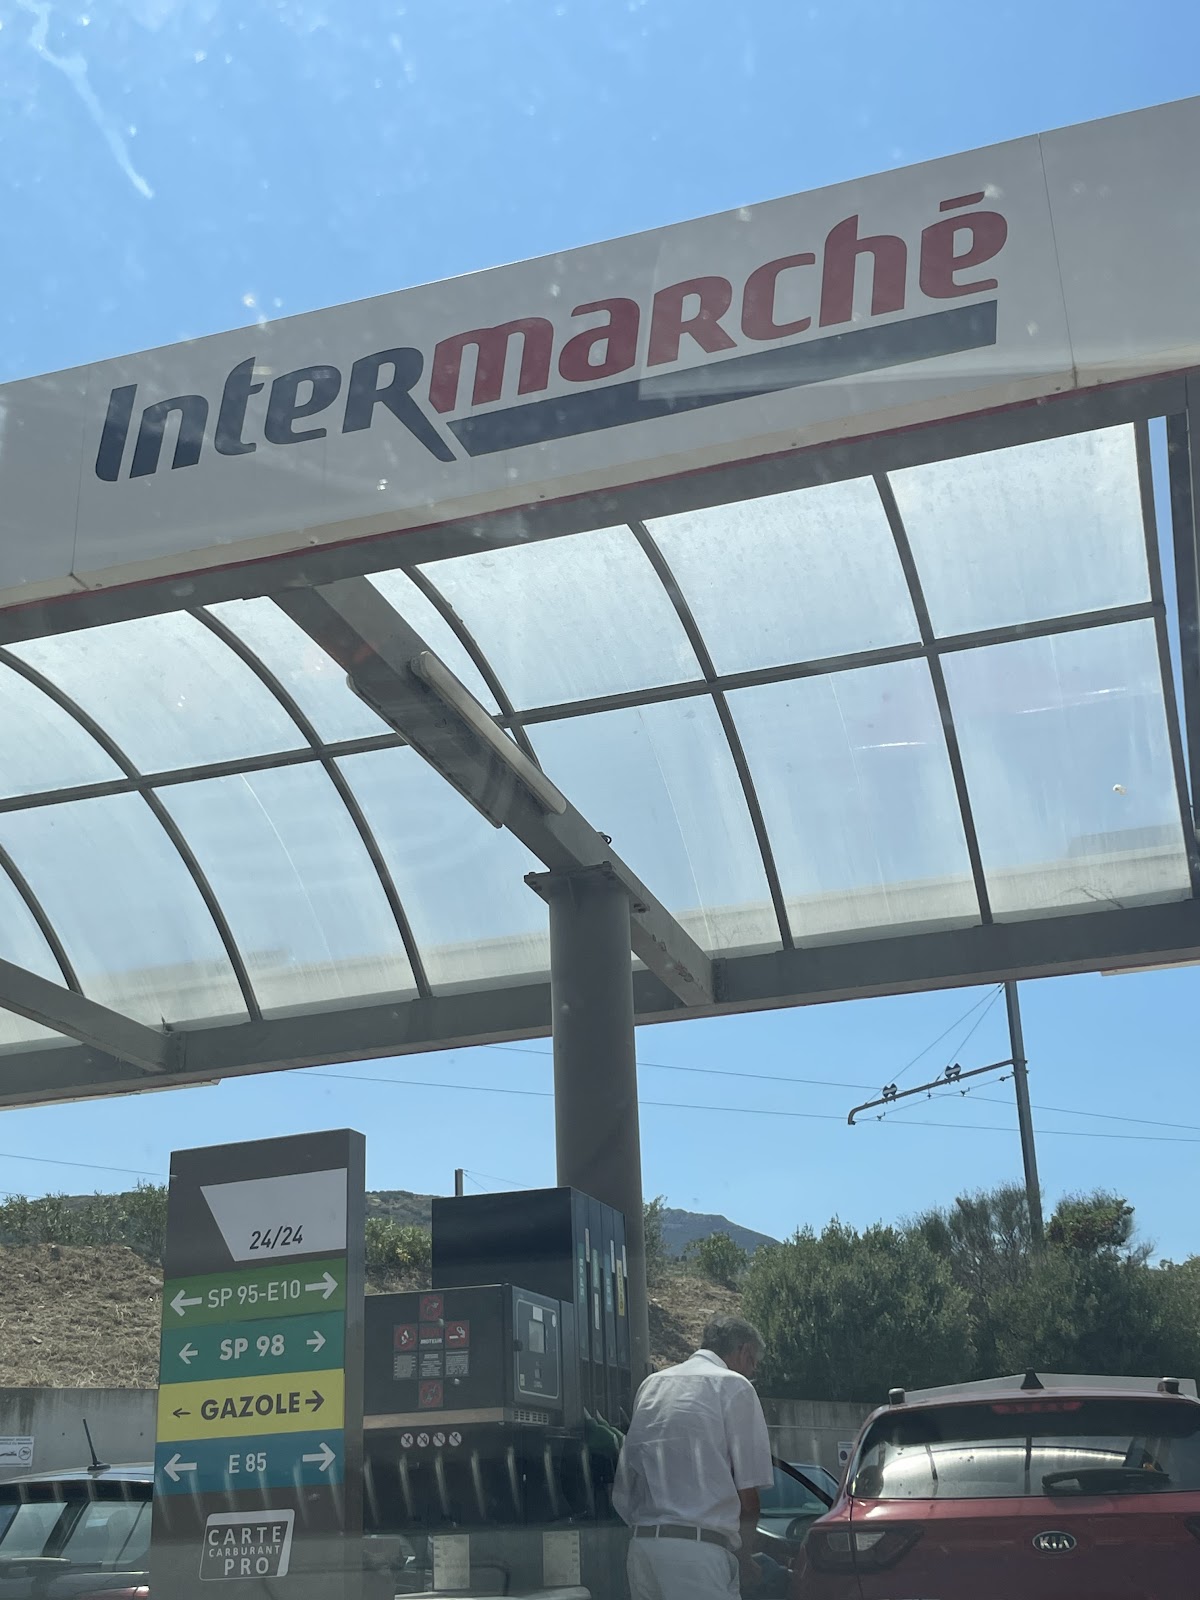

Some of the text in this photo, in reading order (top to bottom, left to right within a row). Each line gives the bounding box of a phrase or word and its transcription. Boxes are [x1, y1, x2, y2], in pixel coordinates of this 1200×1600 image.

[249, 1225, 303, 1250] 24/24
[207, 1279, 301, 1308] SP 95-E10
[219, 1334, 285, 1361] SP 98
[200, 1392, 301, 1421] GAZOLE
[228, 1452, 267, 1474] E 85
[208, 1526, 281, 1546] CARTE
[1039, 1535, 1071, 1550] KIA
[208, 1545, 280, 1558] CARBURANT
[224, 1557, 269, 1576] PRO
